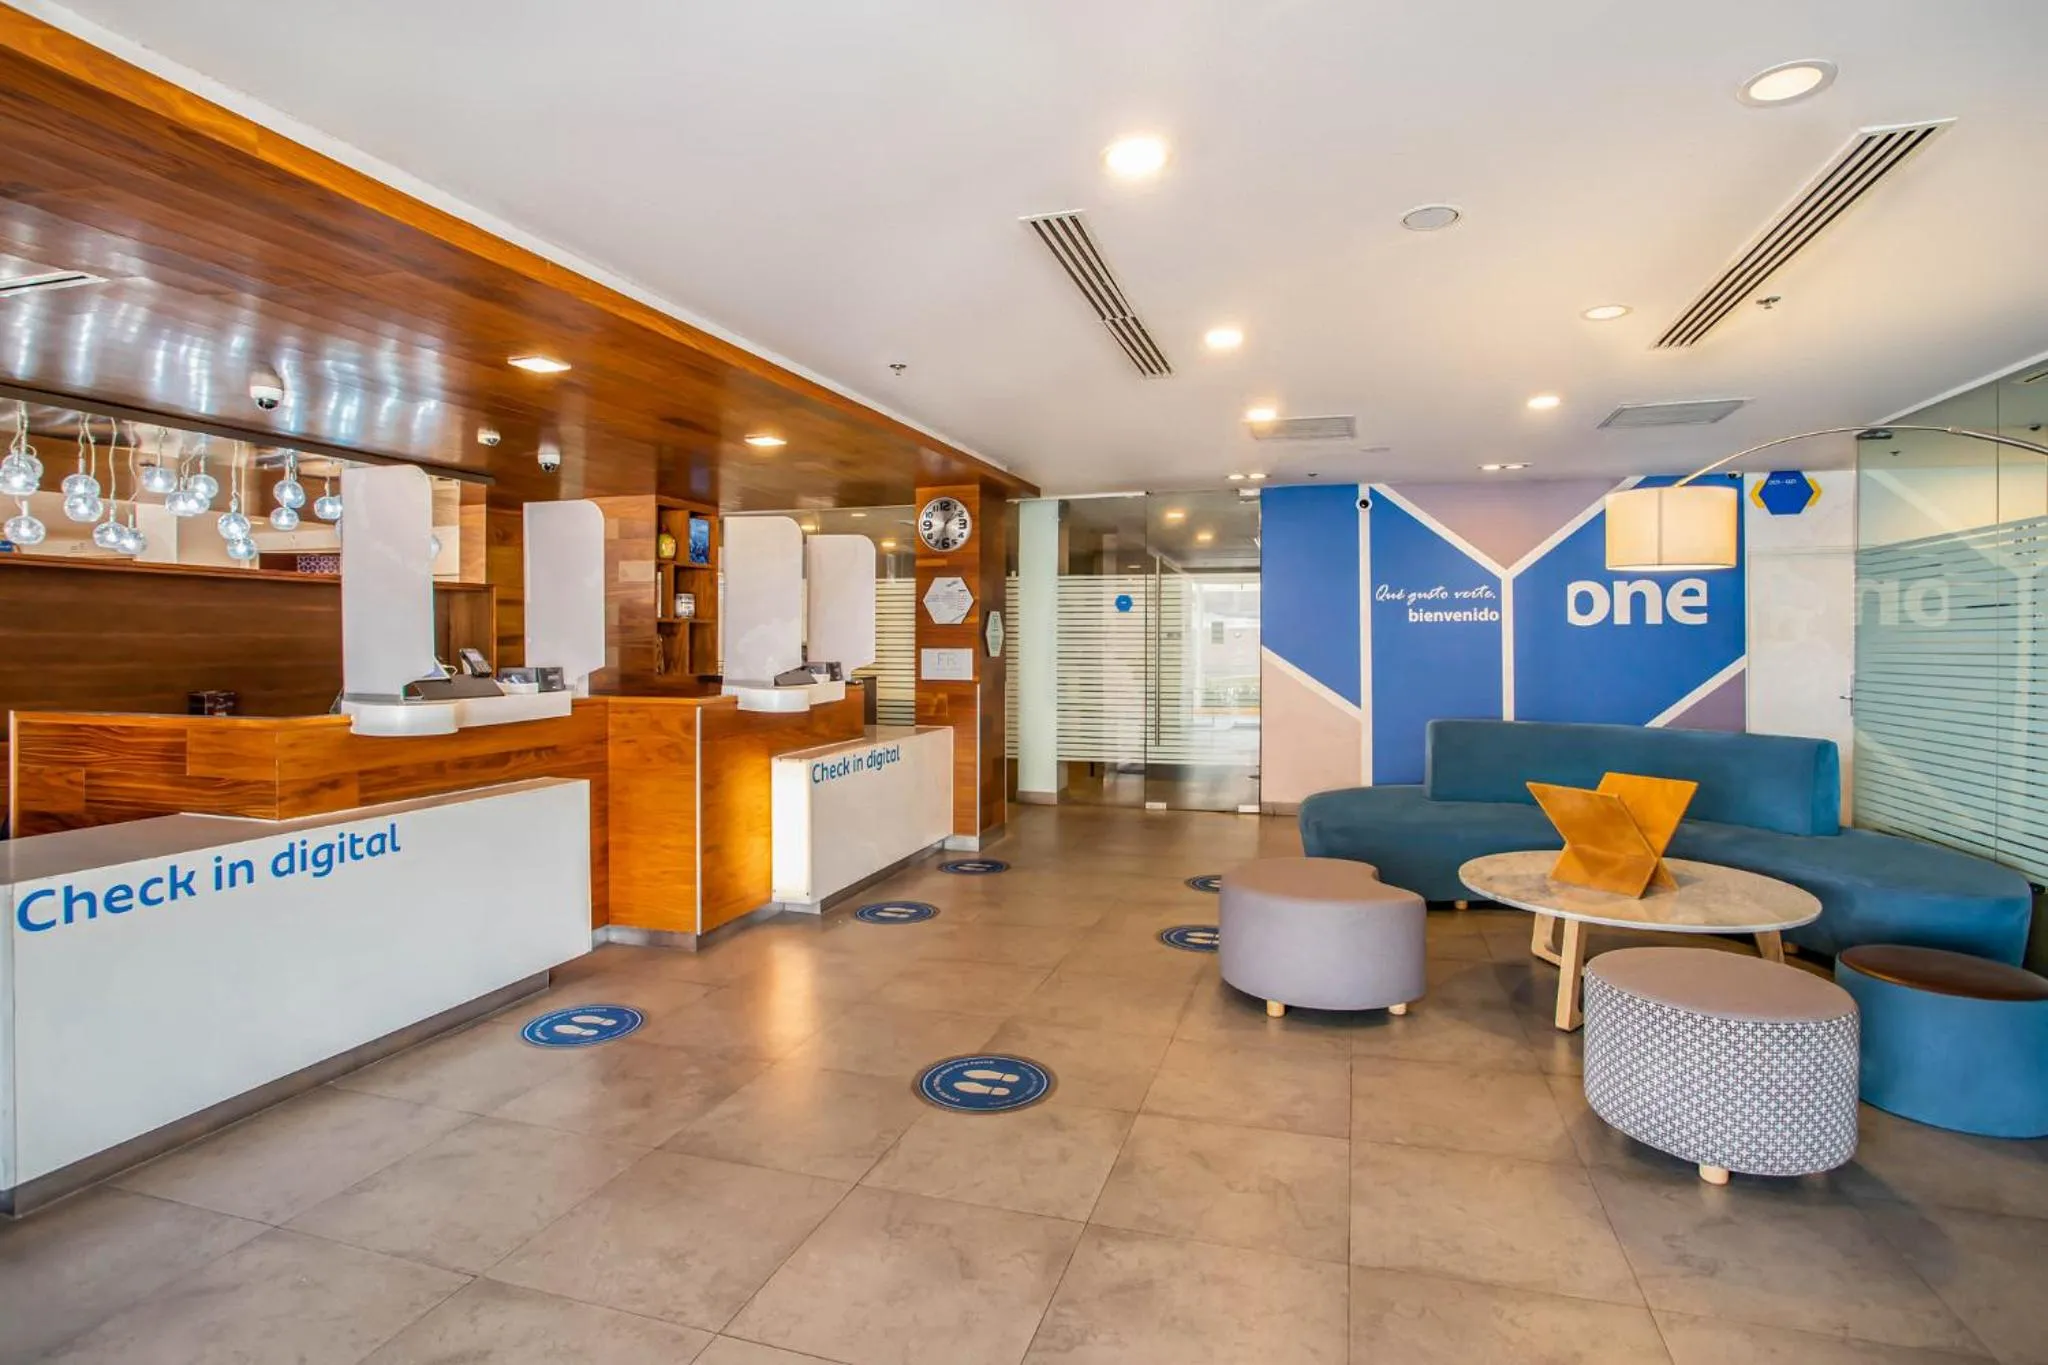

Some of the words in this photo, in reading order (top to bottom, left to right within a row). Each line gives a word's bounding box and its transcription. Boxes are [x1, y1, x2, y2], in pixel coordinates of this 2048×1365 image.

[940, 501, 951, 511] 12
[923, 520, 932, 531] 9
[959, 518, 967, 530] 3
[942, 538, 950, 548] 6
[1407, 586, 1448, 606] gusto
[1567, 578, 1708, 627] one
[1408, 606, 1500, 622] bienvenido
[812, 757, 850, 783] Check
[852, 754, 863, 772] in
[866, 744, 900, 770] digital
[16, 864, 197, 932] Check
[214, 856, 254, 890] in
[271, 823, 401, 878] digital
